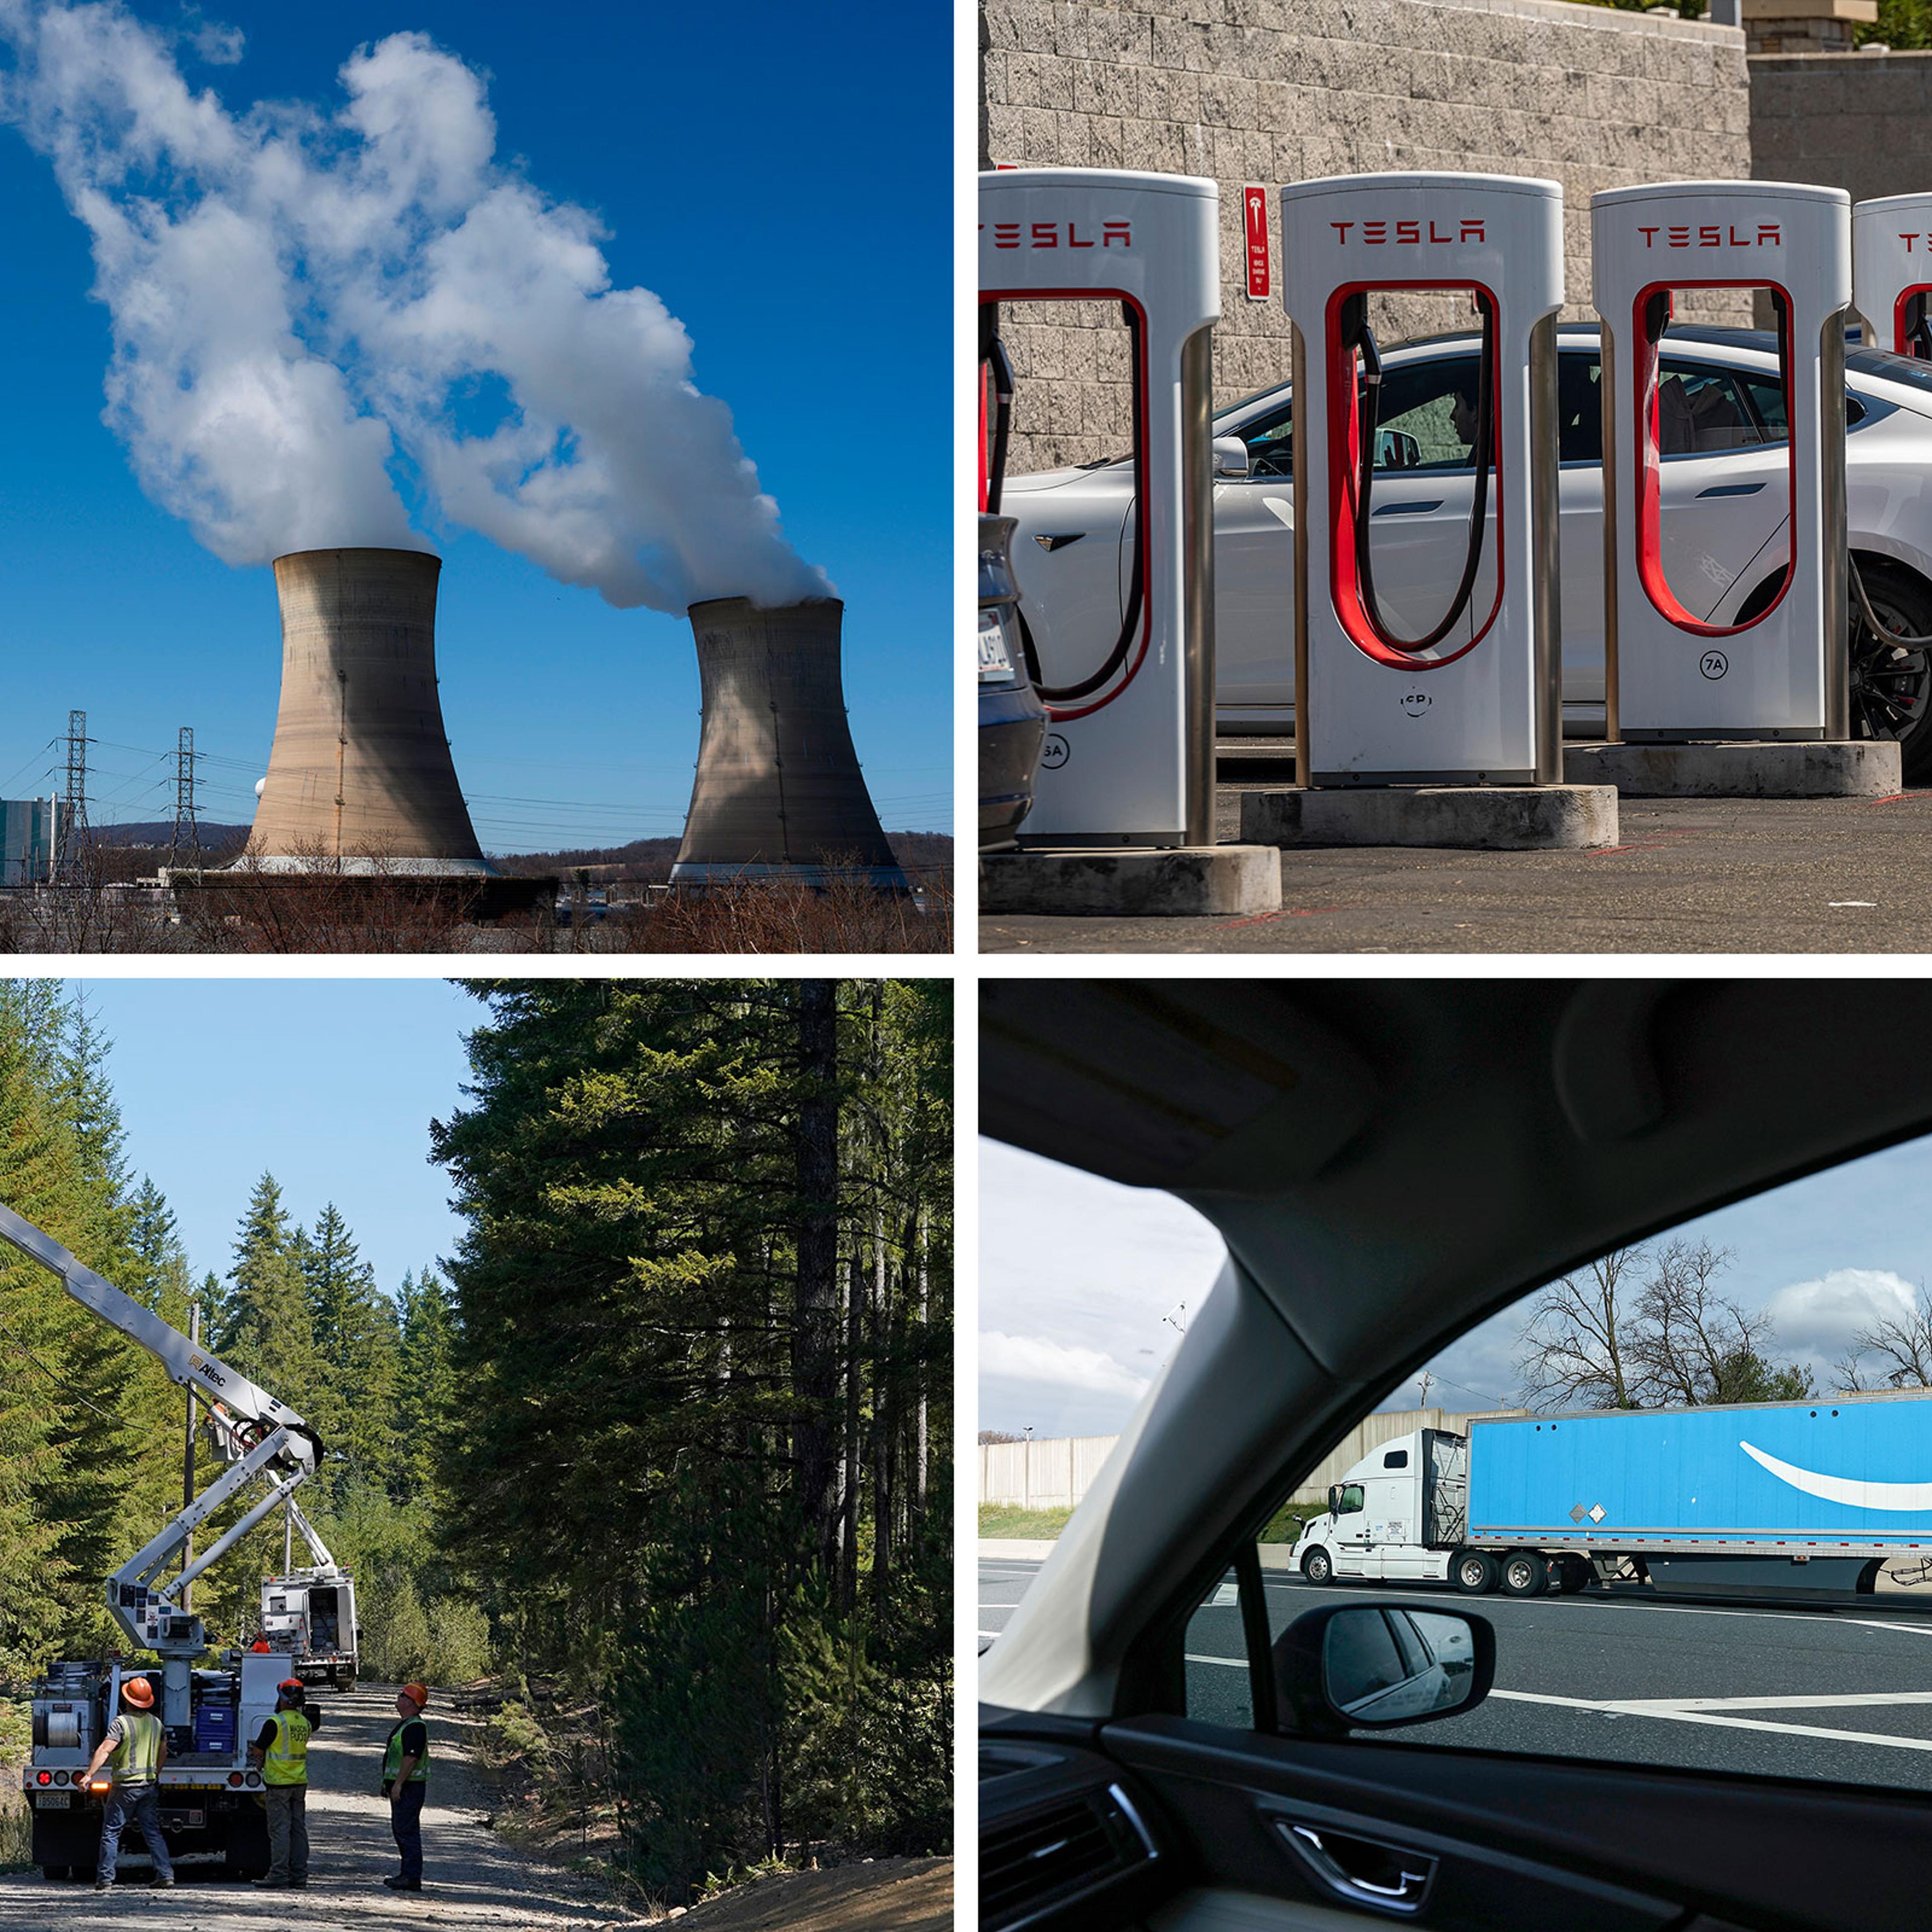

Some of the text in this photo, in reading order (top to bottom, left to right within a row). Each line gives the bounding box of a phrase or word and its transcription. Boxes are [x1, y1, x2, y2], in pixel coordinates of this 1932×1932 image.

[978, 223, 1130, 248] ESLA
[1330, 220, 1485, 245] TESLA
[1638, 225, 1780, 248] TESLA
[1898, 233, 1932, 253] T
[1706, 659, 1723, 670] 7A
[198, 1363, 226, 1387] Altec
